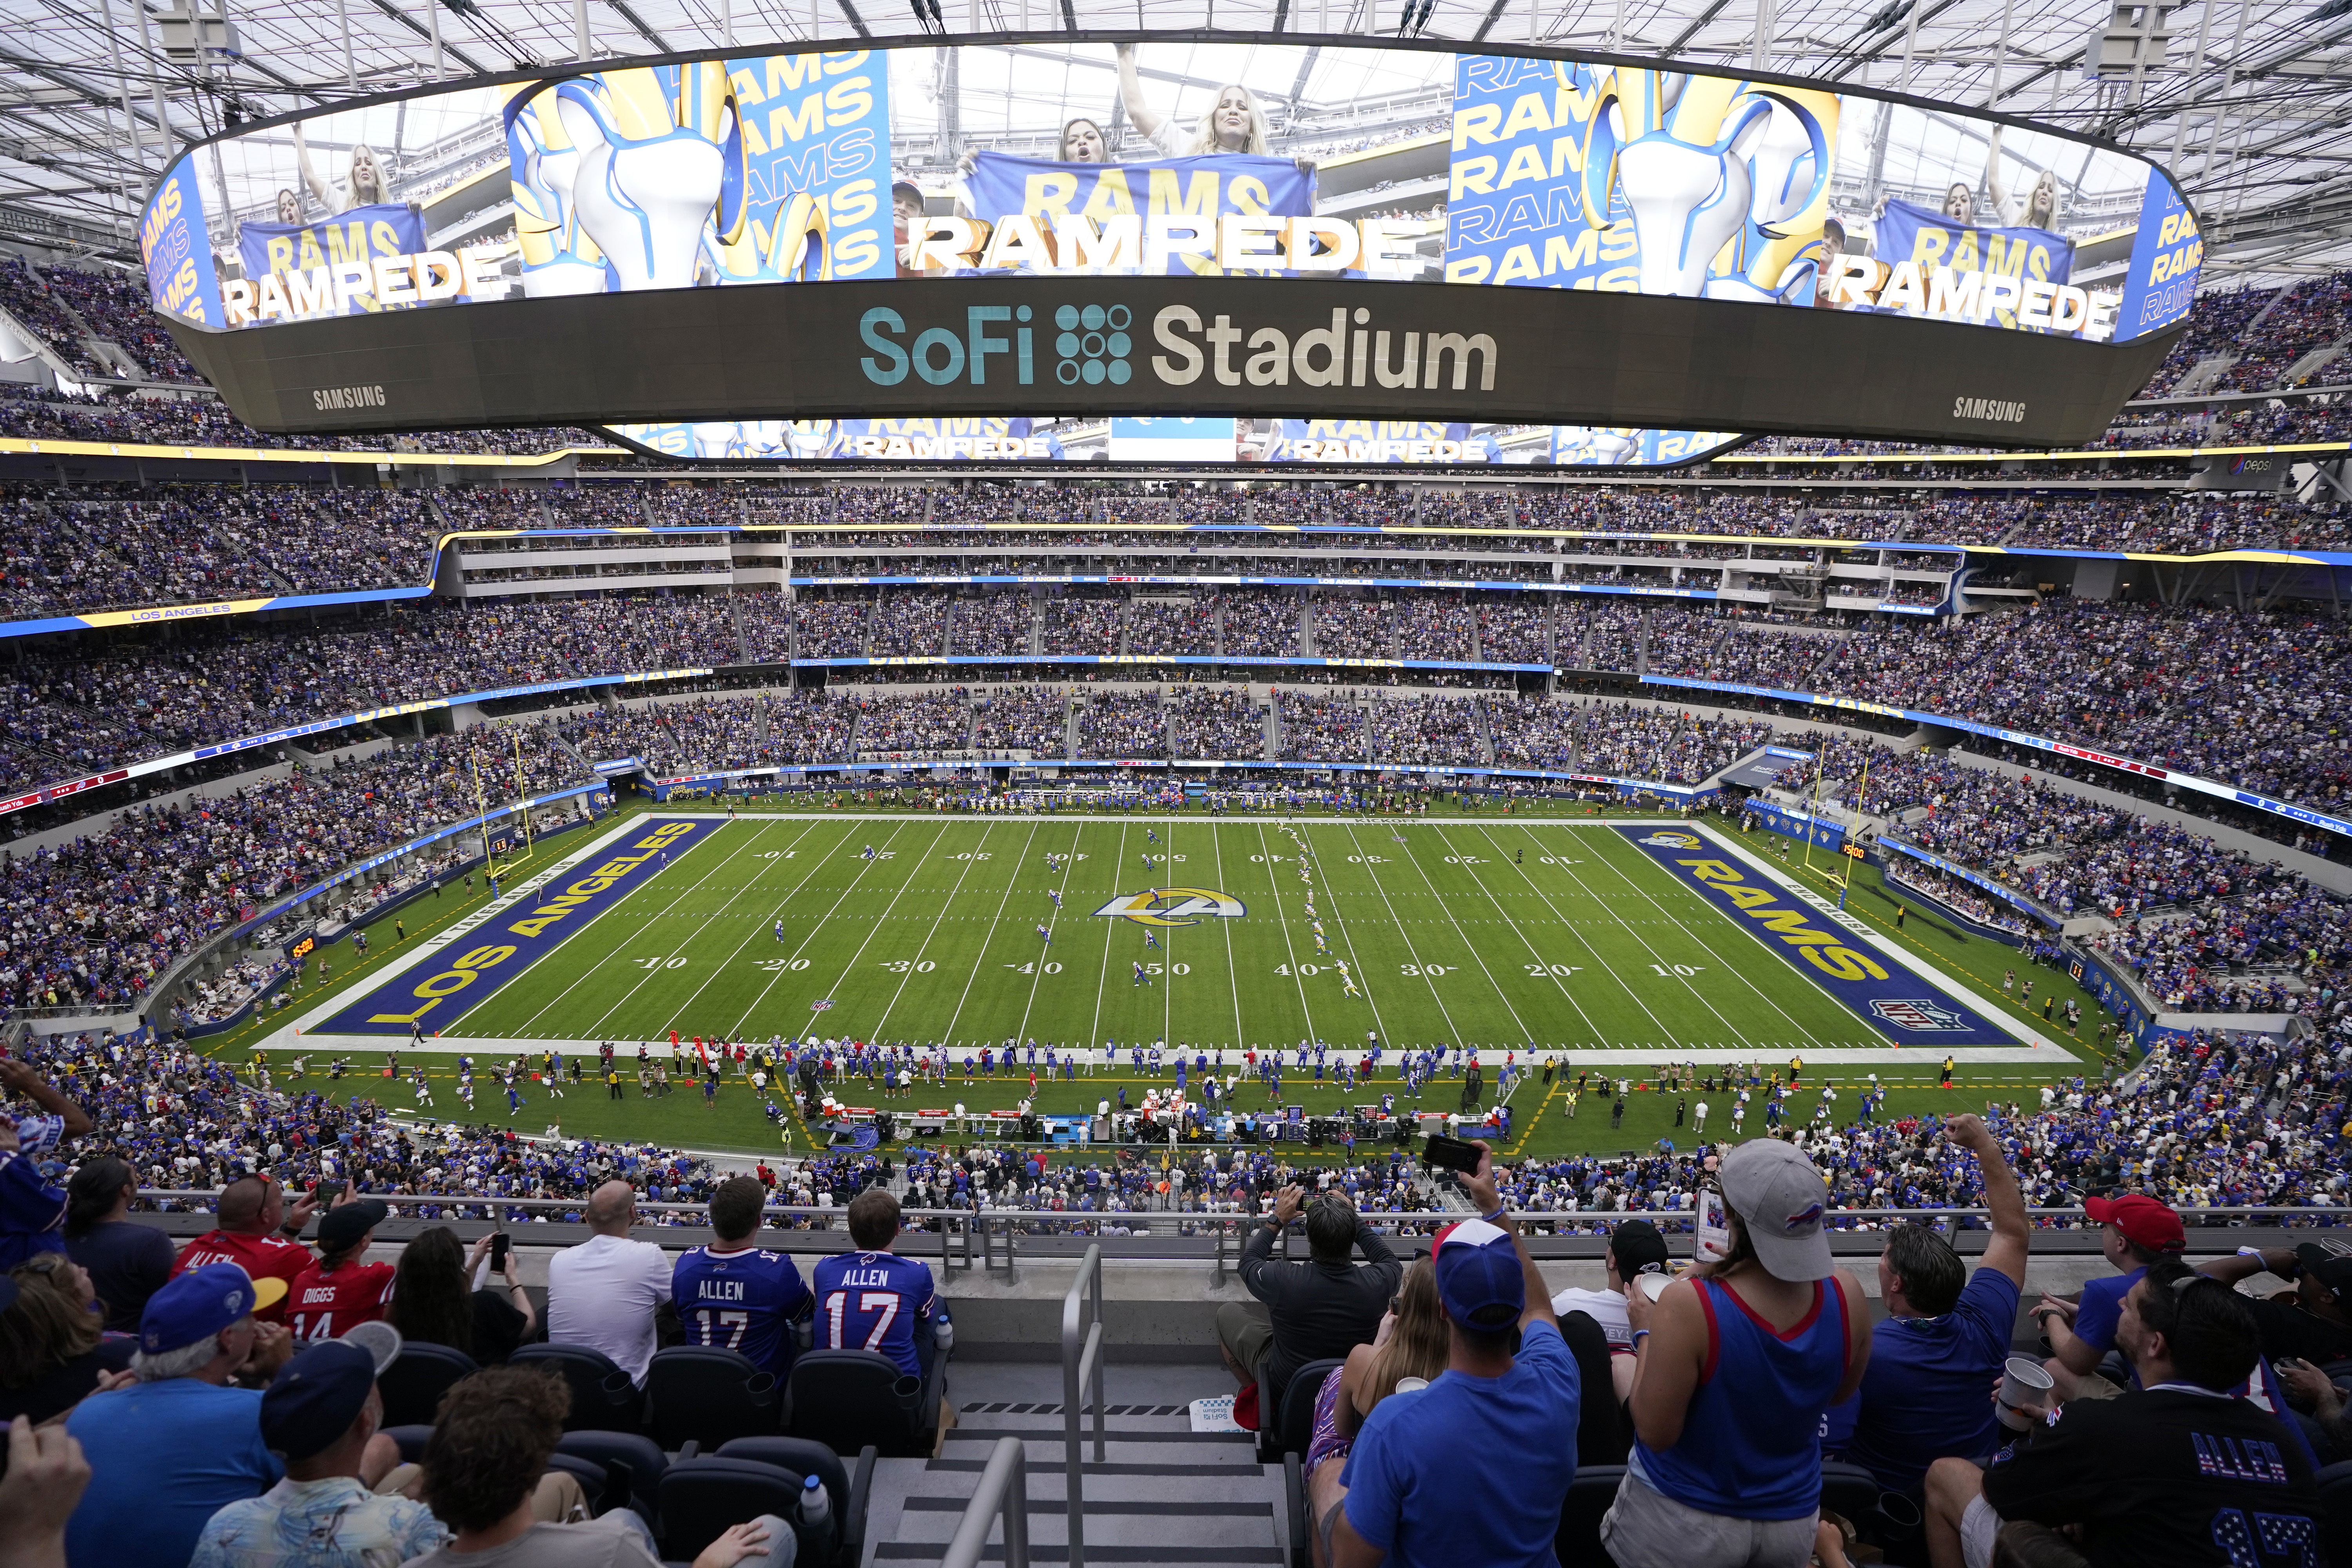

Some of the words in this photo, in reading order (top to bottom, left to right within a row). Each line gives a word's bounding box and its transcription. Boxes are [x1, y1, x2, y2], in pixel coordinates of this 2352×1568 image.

[734, 49, 870, 107] AMS
[743, 75, 873, 158] AMS
[1451, 84, 1602, 153] RAM
[747, 127, 875, 207] AMS
[1449, 134, 1584, 201] RAM
[1446, 183, 1583, 253] RAM
[907, 214, 1427, 274] RAMPEDE
[2148, 240, 2204, 288] RAMS
[162, 257, 198, 313] AMS
[222, 243, 511, 325] RAMPEDE
[1829, 253, 2118, 339] RAMPEDE
[6, 323, 30, 346] CASINO
[859, 305, 1034, 387] SoFi
[1152, 304, 1497, 390] Stadium
[314, 385, 386, 410] SAMSUNG
[1953, 396, 2026, 423] SAMSUNG
[856, 436, 1050, 458] RAMPEDE
[1294, 439, 1488, 461] RAMPEDE
[2243, 458, 2273, 473] pepsi
[132, 610, 160, 621] LOS
[164, 604, 230, 618] ANGELES
[1895, 605, 1935, 615] ANGELES
[2007, 733, 2026, 742] 15:00
[2319, 818, 2333, 829] Rush
[2334, 824, 2347, 833] Yds
[496, 840, 505, 850] 11
[325, 866, 362, 890] RAMS
[368, 844, 413, 869] HOUSE
[508, 822, 696, 938] ANGELES
[1929, 857, 1966, 878] RAMS
[1974, 877, 2016, 904] HOUSE
[427, 936, 452, 945] IT
[449, 903, 506, 931] TAKES
[505, 886, 537, 900] ALL
[555, 861, 575, 870] US
[1786, 884, 1818, 899] END
[1813, 902, 1877, 936] RACISM
[1676, 859, 1889, 980] RAMS
[640, 957, 688, 969] 10
[761, 959, 811, 971] 20
[889, 960, 936, 973] 30
[1017, 962, 1063, 975] 40
[1144, 962, 1191, 976] 50
[1274, 964, 1319, 976] 40
[1401, 964, 1446, 976] 30
[1524, 964, 1572, 977] 20
[1648, 964, 1698, 977] 10
[2072, 964, 2082, 978] 11
[366, 945, 517, 1023] LOS
[1878, 1003, 1937, 1029] NFL
[697, 1279, 744, 1301] ALLEN
[841, 1269, 889, 1288] ALLEN
[302, 1286, 337, 1305] DIGGS
[294, 1312, 333, 1343] 14
[695, 1310, 748, 1352] 17
[824, 1291, 901, 1352] 17
[2190, 1431, 2287, 1485] ALLEN
[2210, 1506, 2318, 1568] 17
